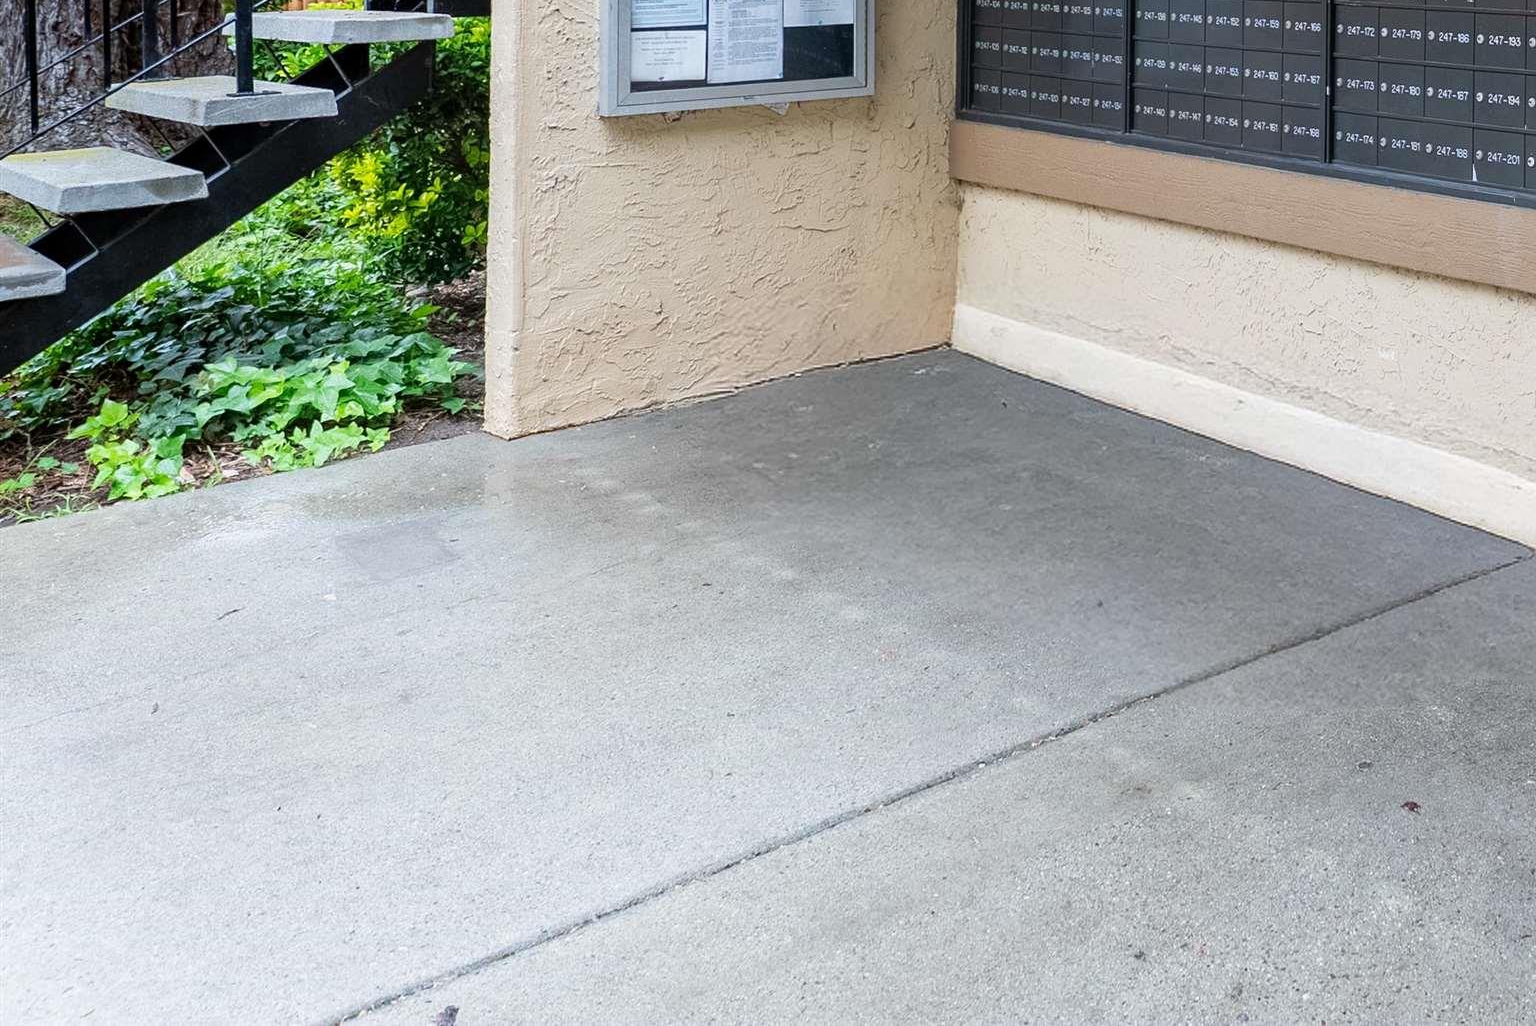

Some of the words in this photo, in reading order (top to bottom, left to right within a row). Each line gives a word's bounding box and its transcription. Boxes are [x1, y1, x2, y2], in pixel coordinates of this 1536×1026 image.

[1348, 26, 1374, 36] 247-172
[1393, 29, 1421, 39] 247-179
[1489, 35, 1521, 46] 247-193
[1347, 79, 1374, 90] 247-173
[1488, 94, 1520, 105] 247-194
[1346, 133, 1373, 144] 247-174
[1488, 152, 1520, 164] 247-201
